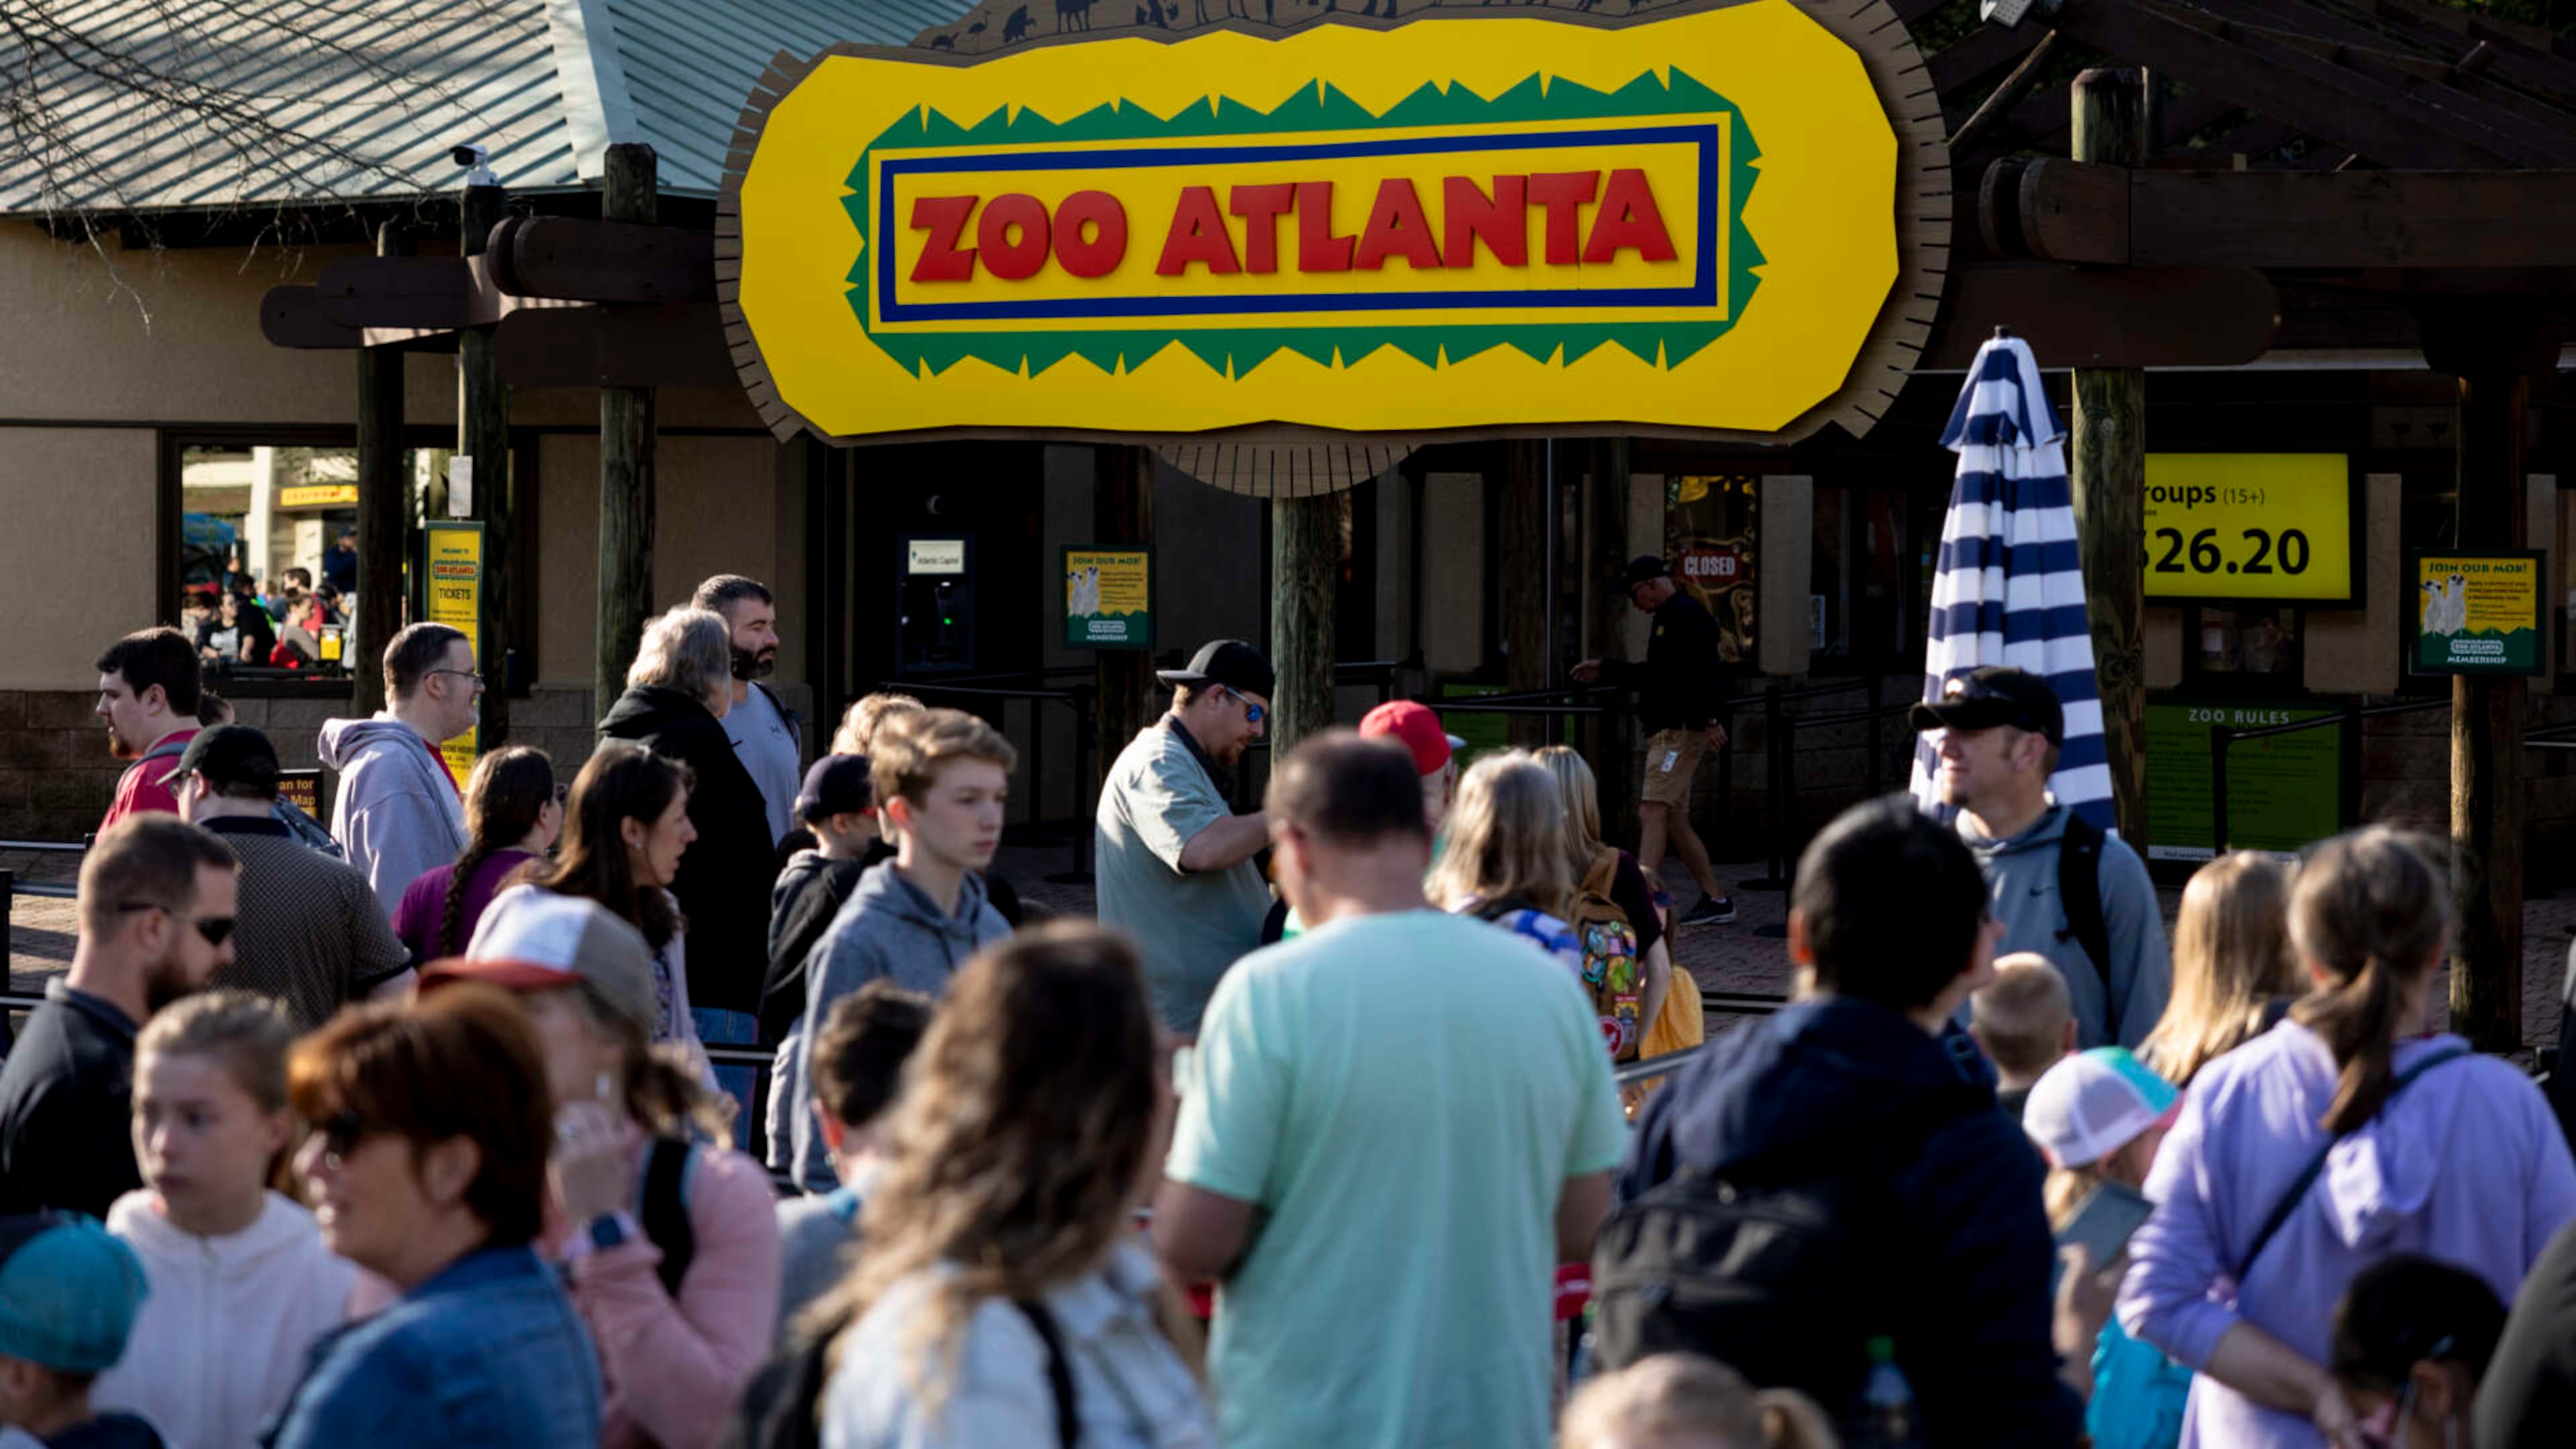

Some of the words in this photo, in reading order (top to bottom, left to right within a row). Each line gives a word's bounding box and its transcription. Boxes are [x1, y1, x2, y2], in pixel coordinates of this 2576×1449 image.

[909, 190, 1128, 282] ZOO
[1155, 168, 1678, 276] ATLANTA
[2223, 488, 2265, 506] (15+)
[449, 566, 474, 574] ATLANTA
[1684, 555, 1736, 576] CLOSED
[2429, 563, 2459, 572] JOIN
[2462, 564, 2489, 573] OUR
[2493, 564, 2528, 573] MOB!
[439, 588, 472, 600] TICKETS
[2447, 655, 2507, 664] MEMBERSHIP
[2189, 708, 2225, 722] ZOO
[2234, 710, 2290, 724] RULES
[277, 780, 294, 791] an
[297, 779, 315, 790] for
[290, 794, 316, 806] Map
